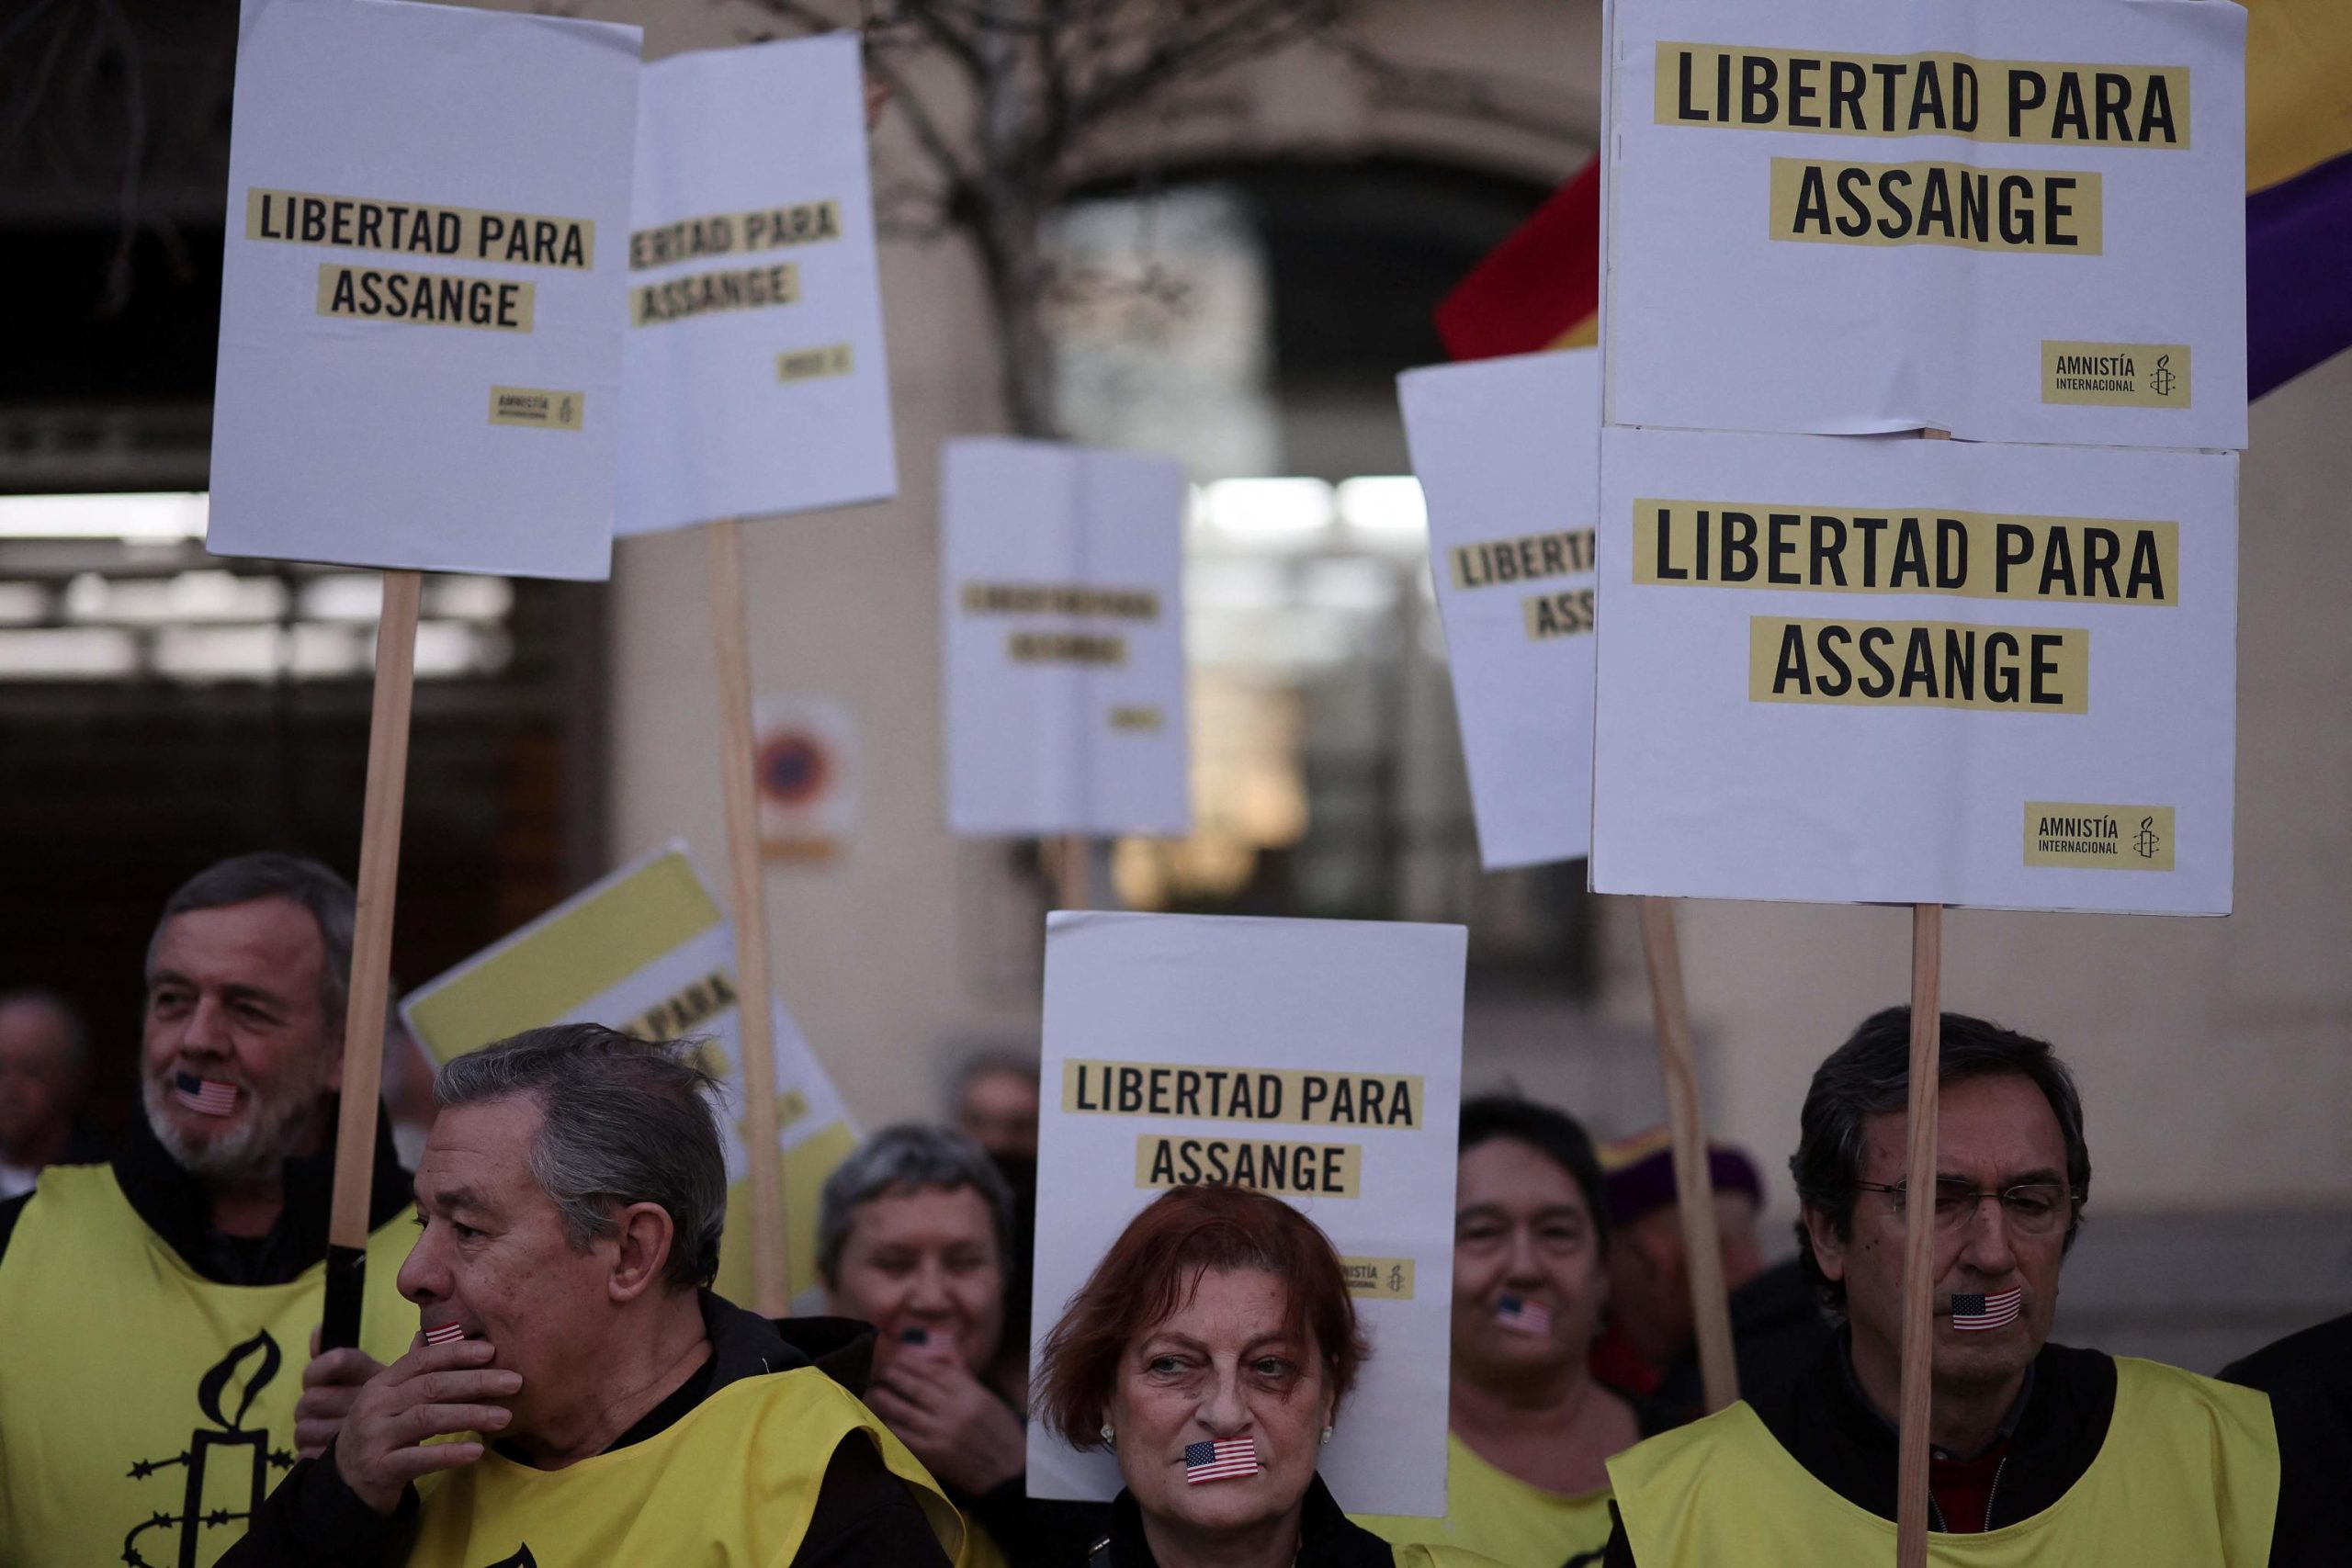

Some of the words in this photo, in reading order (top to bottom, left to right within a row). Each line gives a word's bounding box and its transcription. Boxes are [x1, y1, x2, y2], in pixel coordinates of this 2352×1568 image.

[1678, 51, 1979, 133] LIBERTAD
[2008, 69, 2177, 143] PARA
[260, 194, 461, 255] LIBERTAD
[478, 215, 584, 267] PARA
[1792, 165, 2078, 246] ASSANGE
[630, 217, 733, 269] ERTAD
[744, 204, 838, 250] PARA
[331, 269, 519, 328] ASSANGE
[641, 264, 787, 321] ASSANGE
[2056, 353, 2135, 377] AMNISTÍA
[2056, 378, 2135, 392] INTERNACIONAL
[1459, 529, 1595, 588] LIBERT
[1657, 508, 1969, 590] LIBERTAD
[1996, 523, 2165, 600] PARA
[1771, 624, 2064, 705] ASSANGE
[2039, 815, 2119, 839] AMNISTÍA
[2039, 840, 2118, 854] INTERNACIONAL
[1077, 1065, 1283, 1120] LIBERTAD
[1301, 1076, 1413, 1126] PARA
[1149, 1139, 1345, 1192] ASSANGE
